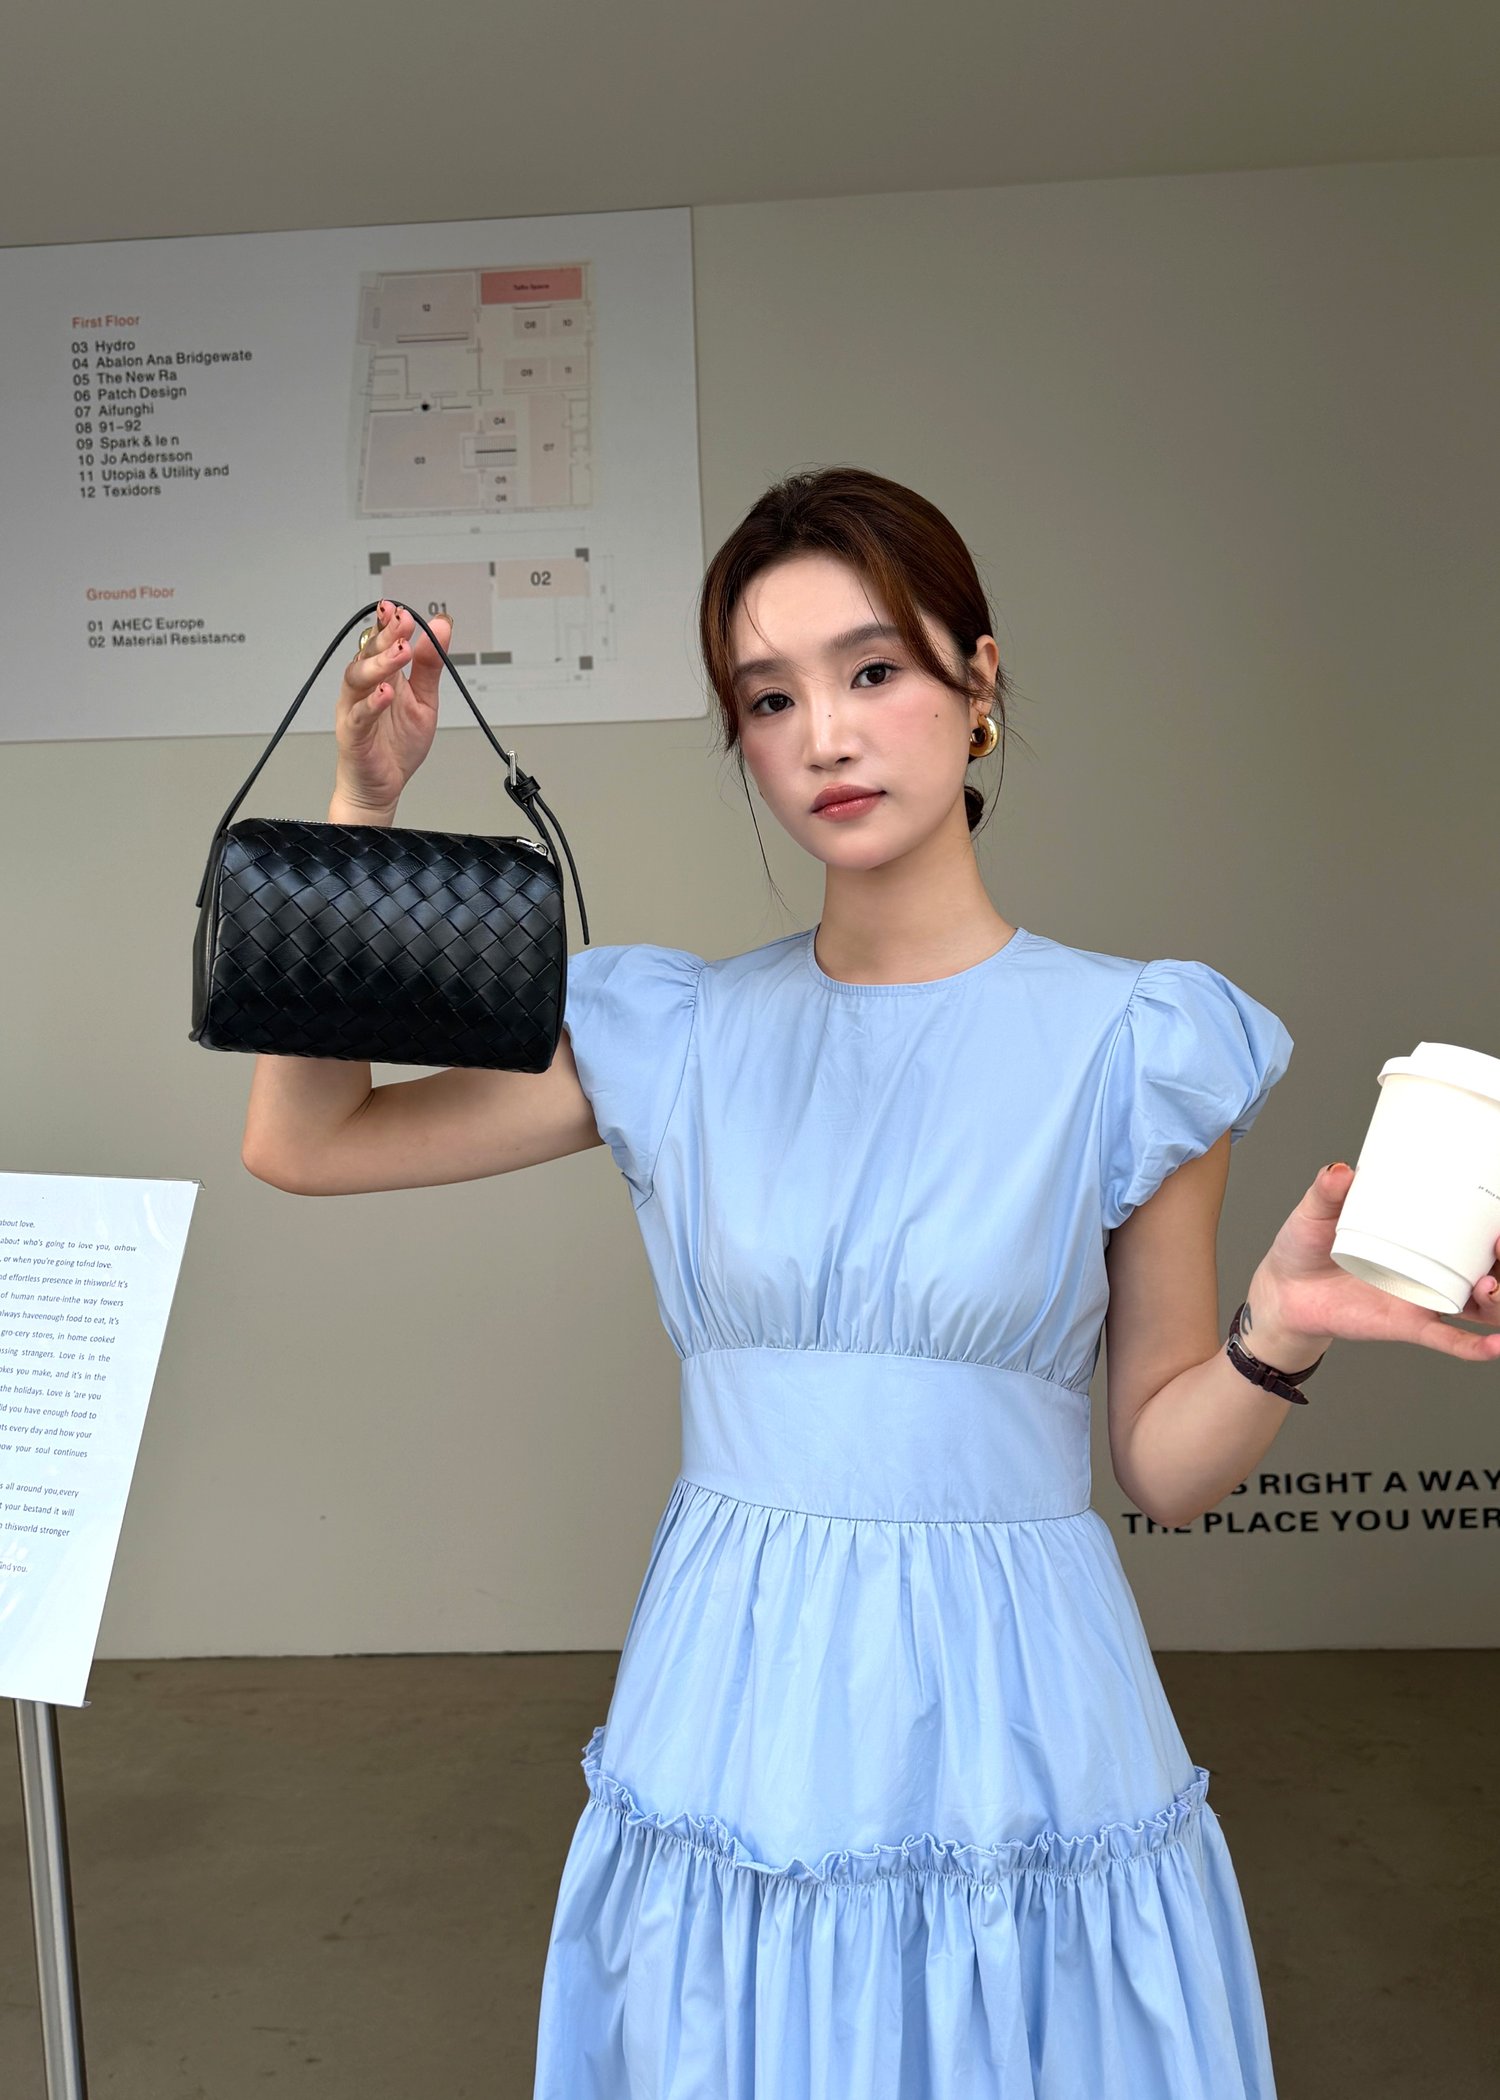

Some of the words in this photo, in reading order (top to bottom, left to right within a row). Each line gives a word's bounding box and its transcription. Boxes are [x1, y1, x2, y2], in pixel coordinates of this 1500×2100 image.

[72, 315, 102, 329] First
[105, 314, 140, 327] Floor
[71, 341, 88, 354] 03
[95, 339, 136, 354] Hydro
[72, 357, 89, 370] 04
[96, 354, 143, 369] Abalon
[146, 352, 173, 366] Ana
[176, 349, 252, 366] Bridgewate
[73, 373, 90, 386] 05
[98, 371, 122, 385] The
[126, 369, 155, 383] New
[159, 368, 177, 382] Ra
[74, 390, 91, 402] 06
[98, 387, 136, 401] Patch
[140, 385, 187, 400] Design
[75, 406, 91, 419] 07
[98, 403, 154, 419] Aifunghi
[75, 421, 93, 434] 08
[77, 437, 93, 450] 09
[100, 436, 140, 450] Spark
[143, 436, 152, 448] &
[78, 454, 94, 466] 10
[101, 454, 117, 466] Jo
[121, 451, 193, 464] Andersson
[80, 471, 94, 482] 11
[102, 468, 146, 482] Utopia
[149, 468, 158, 480] &
[162, 465, 201, 480] Utility
[204, 464, 230, 477] and
[80, 487, 96, 498] 12
[103, 485, 161, 498] Texidors
[530, 571, 552, 586] 02
[86, 588, 137, 601] Ground
[140, 586, 175, 599] Floor
[428, 602, 447, 616] 01
[88, 620, 104, 632] 01
[112, 617, 152, 631] AHEC
[156, 617, 205, 631] Europe
[89, 636, 105, 648] 02
[112, 634, 167, 648] Material
[171, 631, 246, 645] Resistance
[20, 1220, 35, 1228] love.
[23, 1239, 43, 1247] who's
[45, 1239, 65, 1249] going
[78, 1241, 93, 1249] love
[96, 1243, 110, 1251] you,
[13, 1255, 31, 1263] when
[33, 1257, 54, 1266] you're
[55, 1258, 75, 1268] going
[96, 1260, 113, 1269] love.
[8, 1273, 40, 1283] effortless
[42, 1276, 73, 1285] presence
[1, 1291, 8, 1299] of
[11, 1292, 34, 1301] human
[83, 1298, 98, 1306] way
[100, 1298, 124, 1307] fowers
[22, 1311, 64, 1322] haveenough
[66, 1313, 82, 1323] food
[93, 1317, 106, 1325] eat,
[32, 1331, 55, 1340] stores,
[58, 1332, 64, 1340] in
[67, 1333, 87, 1342] home
[90, 1335, 115, 1344] cooked
[0, 1347, 19, 1357] ssing
[21, 1349, 55, 1359] strangers.
[59, 1351, 75, 1360] Love
[79, 1352, 85, 1361] is
[88, 1353, 95, 1361] in
[98, 1354, 110, 1363] the
[16, 1367, 30, 1376] you
[32, 1368, 53, 1378] make,
[55, 1370, 70, 1379] and
[71, 1371, 82, 1380] it's
[85, 1372, 91, 1380] in
[94, 1373, 106, 1381] the
[0, 1384, 12, 1393] the
[14, 1385, 44, 1397] holidays.
[47, 1388, 63, 1397] Love
[65, 1390, 71, 1398] is
[88, 1392, 102, 1401] you
[9, 1405, 22, 1413] you
[24, 1405, 41, 1415] have
[43, 1408, 69, 1418] enough
[71, 1409, 88, 1419] food
[89, 1412, 97, 1420] to
[9, 1425, 29, 1434] every
[30, 1425, 43, 1436] day
[44, 1428, 58, 1436] and
[59, 1428, 74, 1437] how
[76, 1431, 92, 1439] your
[15, 1444, 32, 1453] your
[35, 1446, 50, 1455] soul
[53, 1449, 88, 1458] continues
[6, 1481, 15, 1490] all
[16, 1484, 42, 1493] around
[1259, 1471, 1372, 1495] RIGHT
[1384, 1471, 1407, 1493] A
[1418, 1469, 1500, 1492] WAY
[5, 1503, 21, 1511] your
[54, 1506, 60, 1515] it
[62, 1507, 75, 1517] will
[1204, 1510, 1319, 1534] PLACE
[1331, 1508, 1409, 1531] YOU
[1421, 1507, 1500, 1529] WER
[40, 1526, 70, 1537] stronger
[13, 1564, 28, 1573] you.
